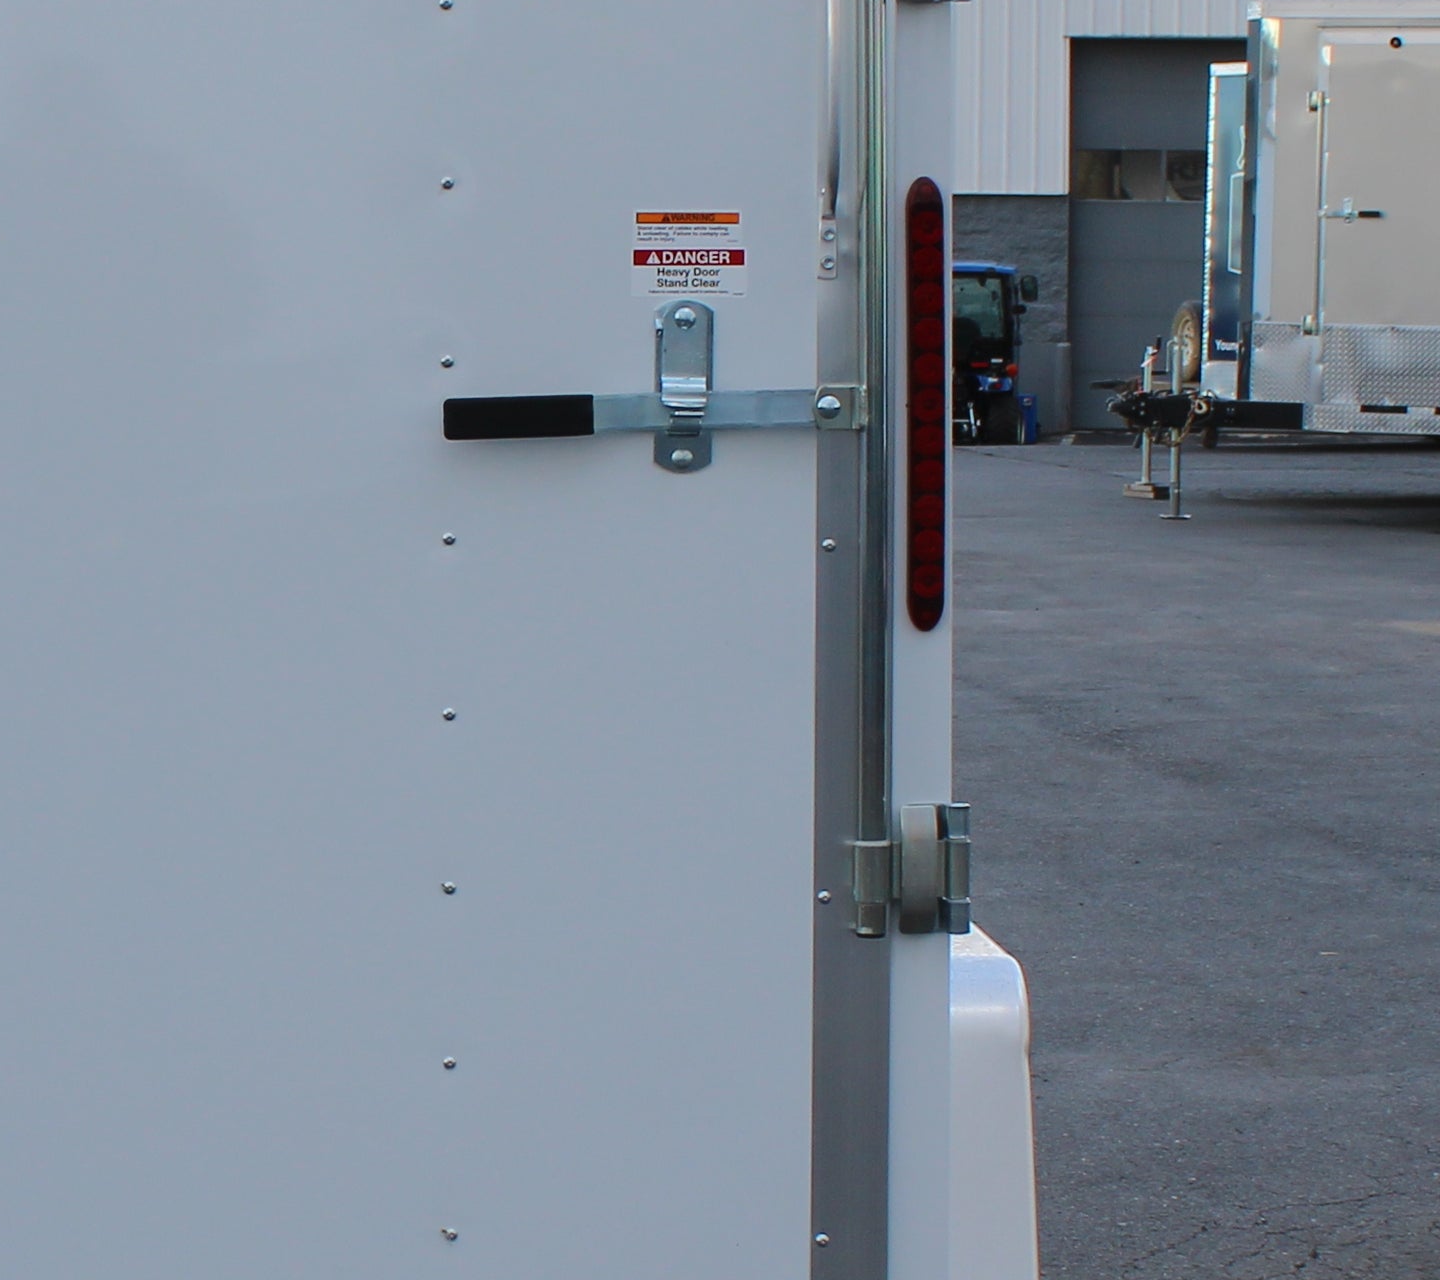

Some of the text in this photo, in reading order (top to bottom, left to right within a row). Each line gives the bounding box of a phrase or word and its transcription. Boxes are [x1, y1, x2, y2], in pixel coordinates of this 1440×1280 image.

[671, 213, 715, 221] WARNING
[662, 251, 730, 264] DANGER
[657, 267, 721, 278] Heavy Door
[657, 278, 721, 288] Stand Clear
